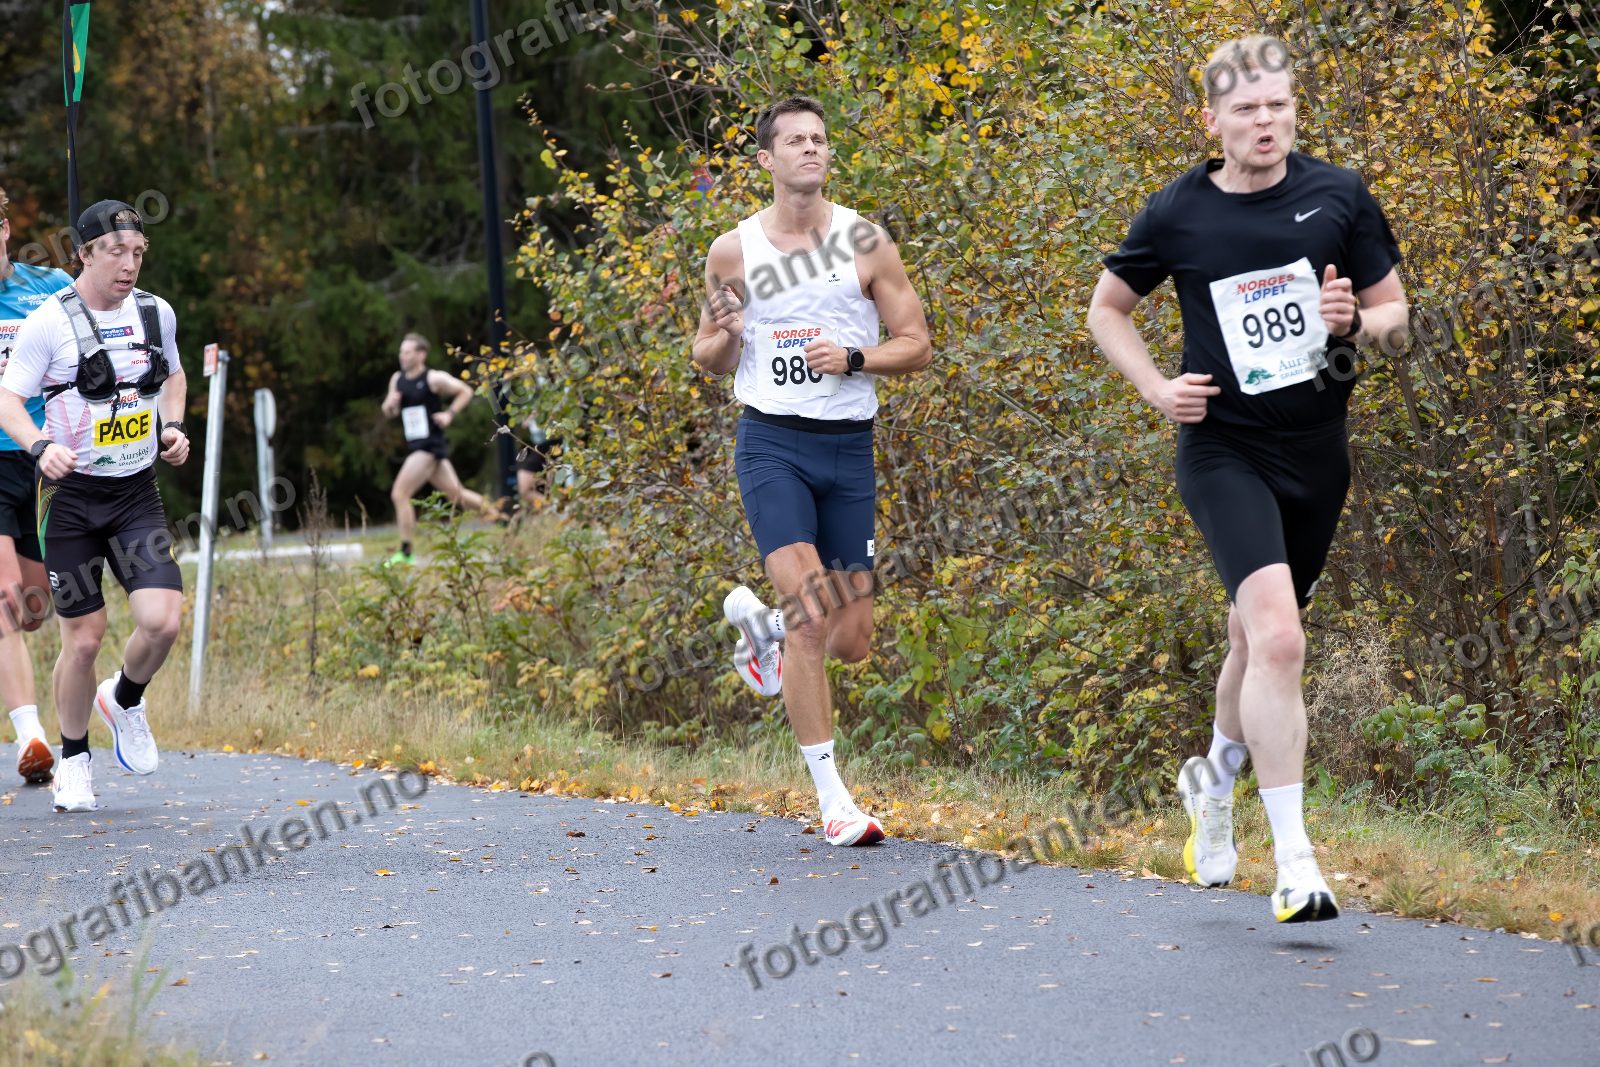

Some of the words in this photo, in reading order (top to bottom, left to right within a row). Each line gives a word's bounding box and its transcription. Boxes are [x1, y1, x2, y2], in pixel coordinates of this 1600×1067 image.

[1236, 274, 1296, 294] NORGES
[1244, 283, 1288, 304] LØPET
[772, 328, 821, 339] NORGES
[1242, 302, 1306, 348] 989
[99, 414, 148, 442] PACE
